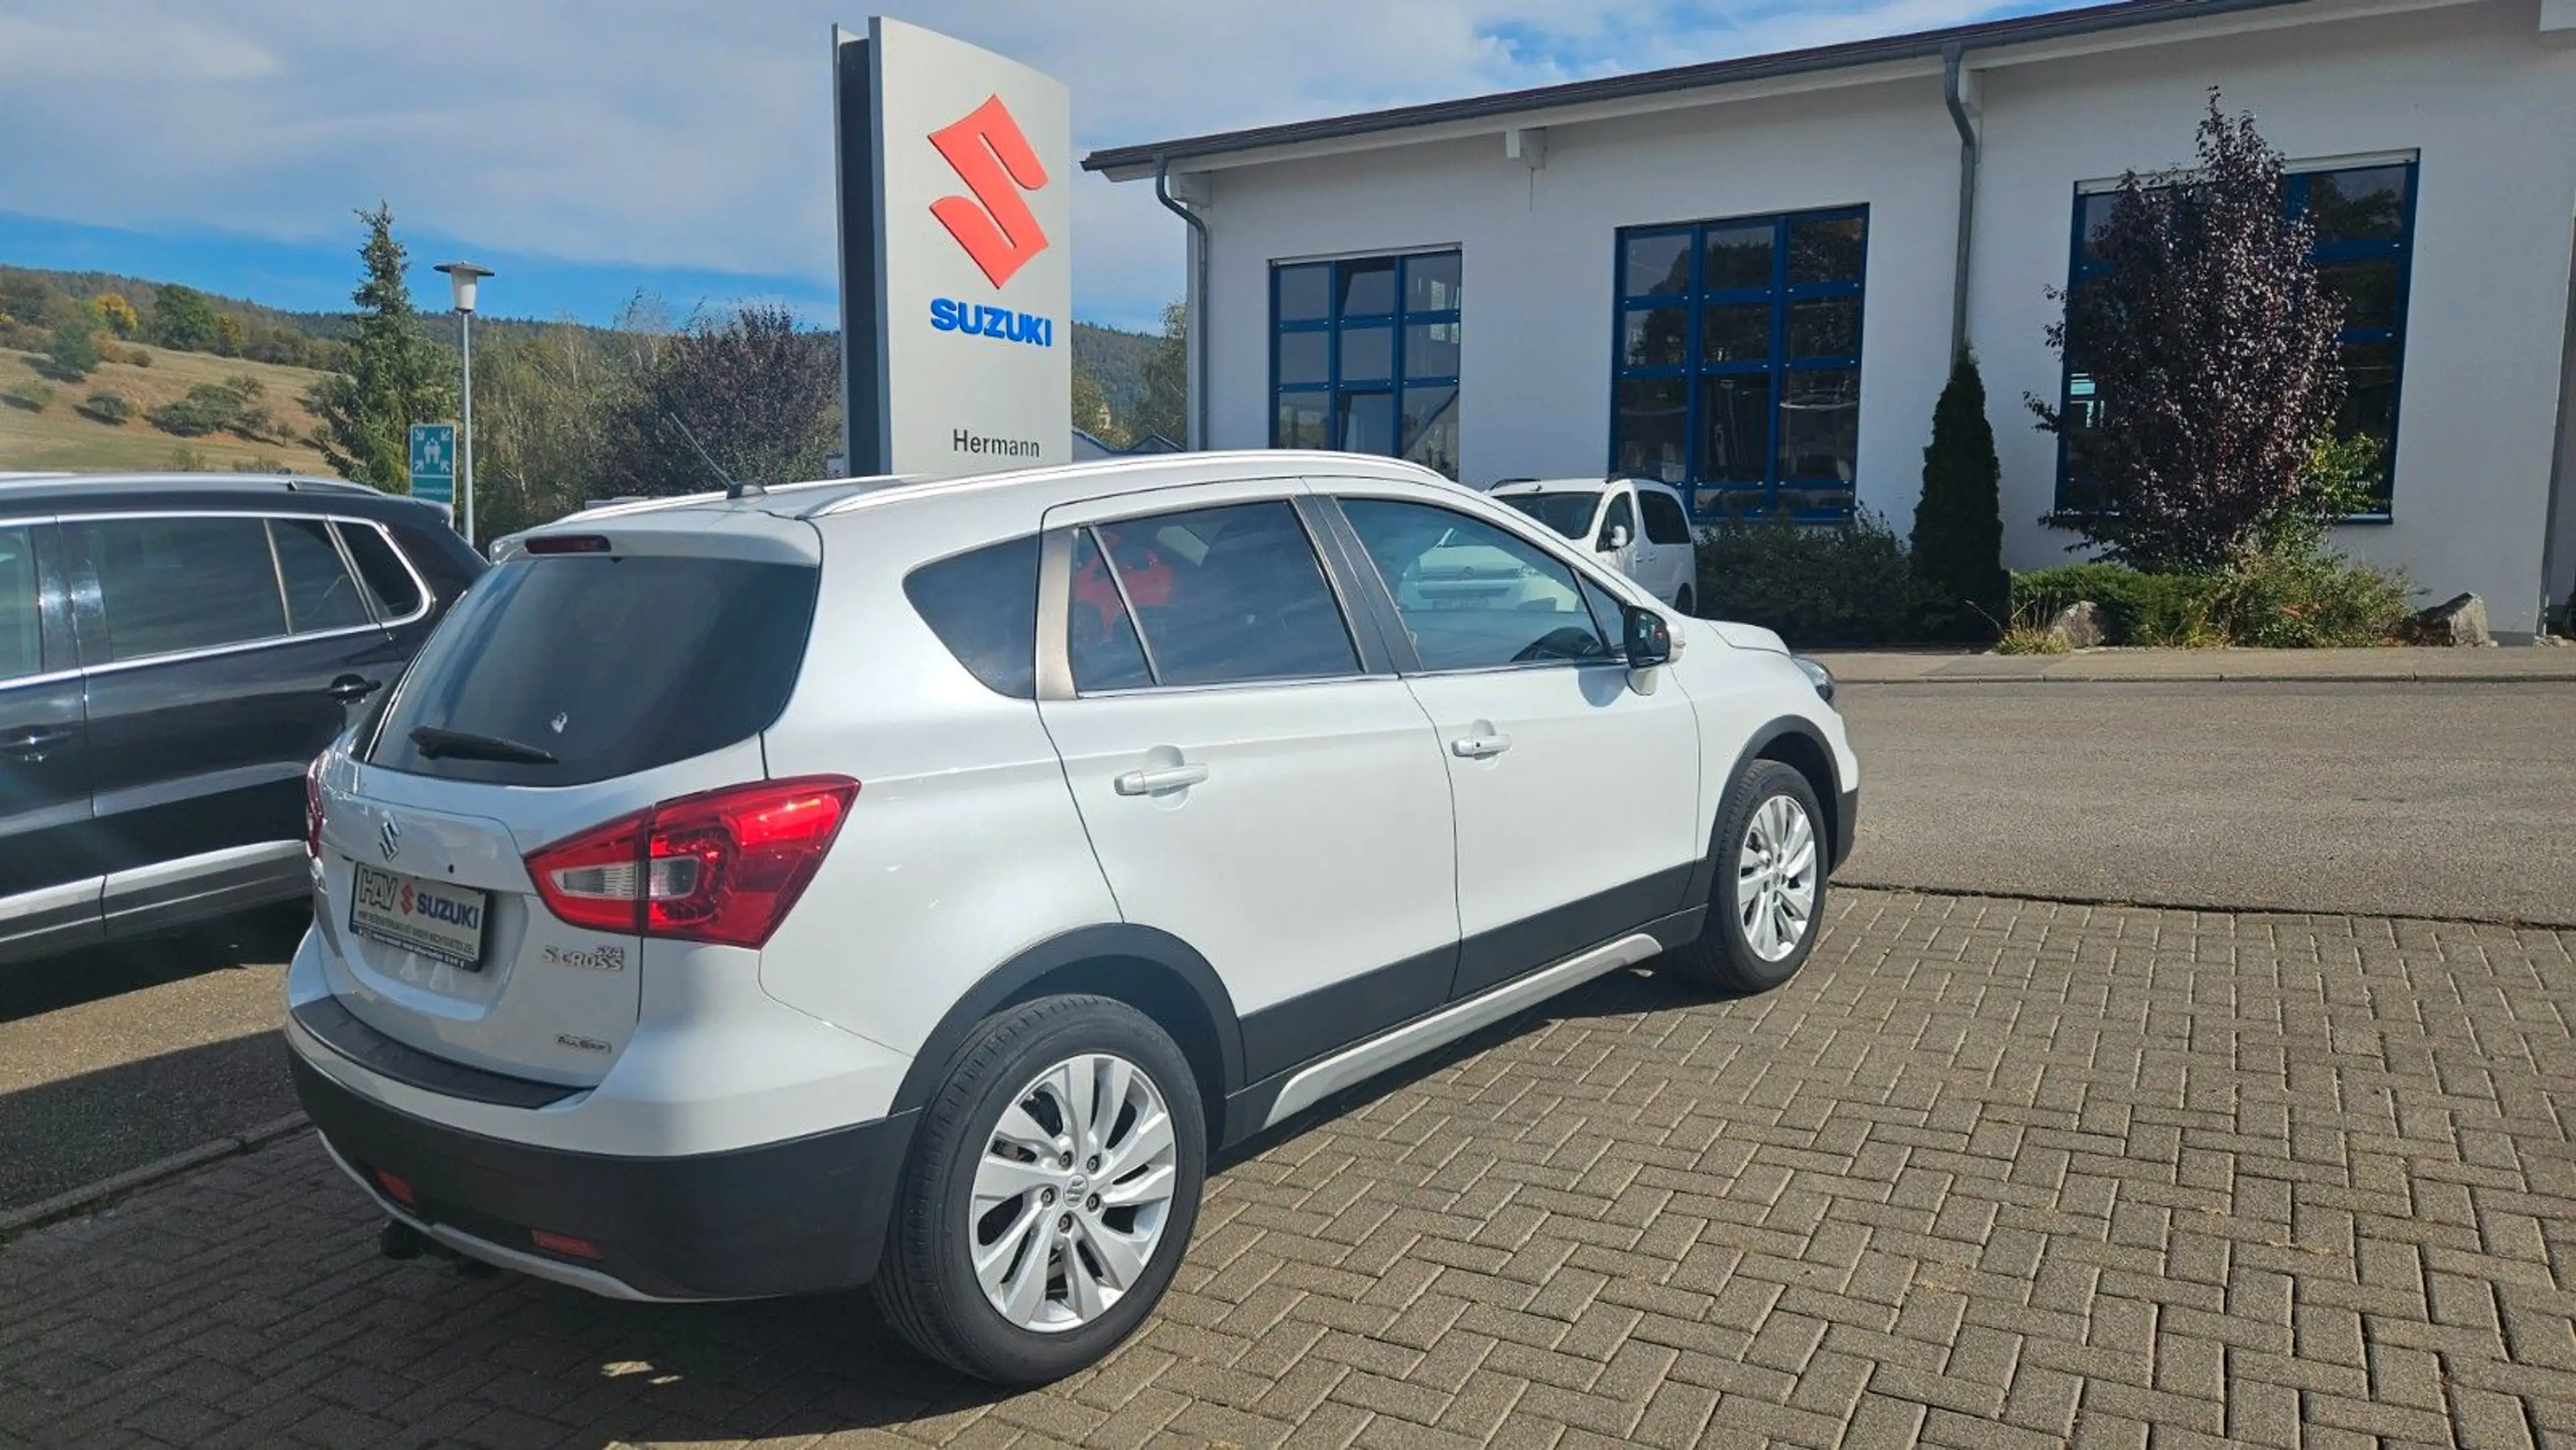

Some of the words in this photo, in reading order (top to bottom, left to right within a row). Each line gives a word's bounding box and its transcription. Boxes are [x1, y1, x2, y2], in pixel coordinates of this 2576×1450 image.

[930, 298, 1052, 347] SUZUKI
[953, 428, 1040, 458] Hermann
[358, 869, 398, 911] HAV
[417, 893, 480, 930] SUZUKI
